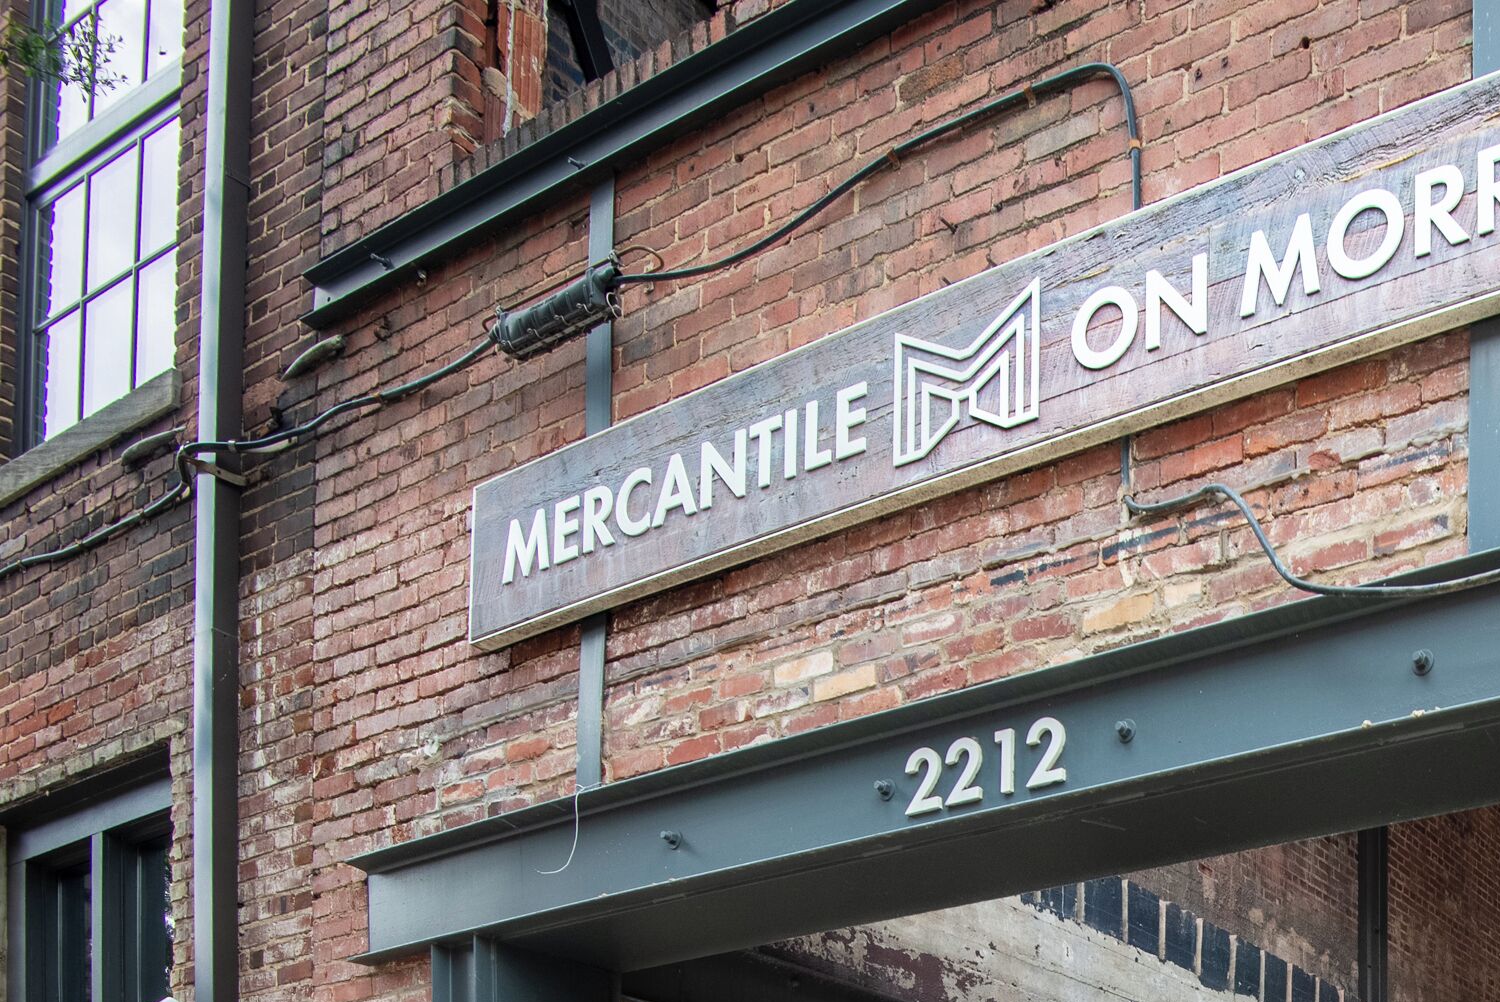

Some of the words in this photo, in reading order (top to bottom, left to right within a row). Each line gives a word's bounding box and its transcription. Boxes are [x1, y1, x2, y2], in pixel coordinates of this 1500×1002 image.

[502, 380, 869, 585] MERCANTILE
[1070, 251, 1207, 370] ON
[904, 716, 1067, 816] 2212
